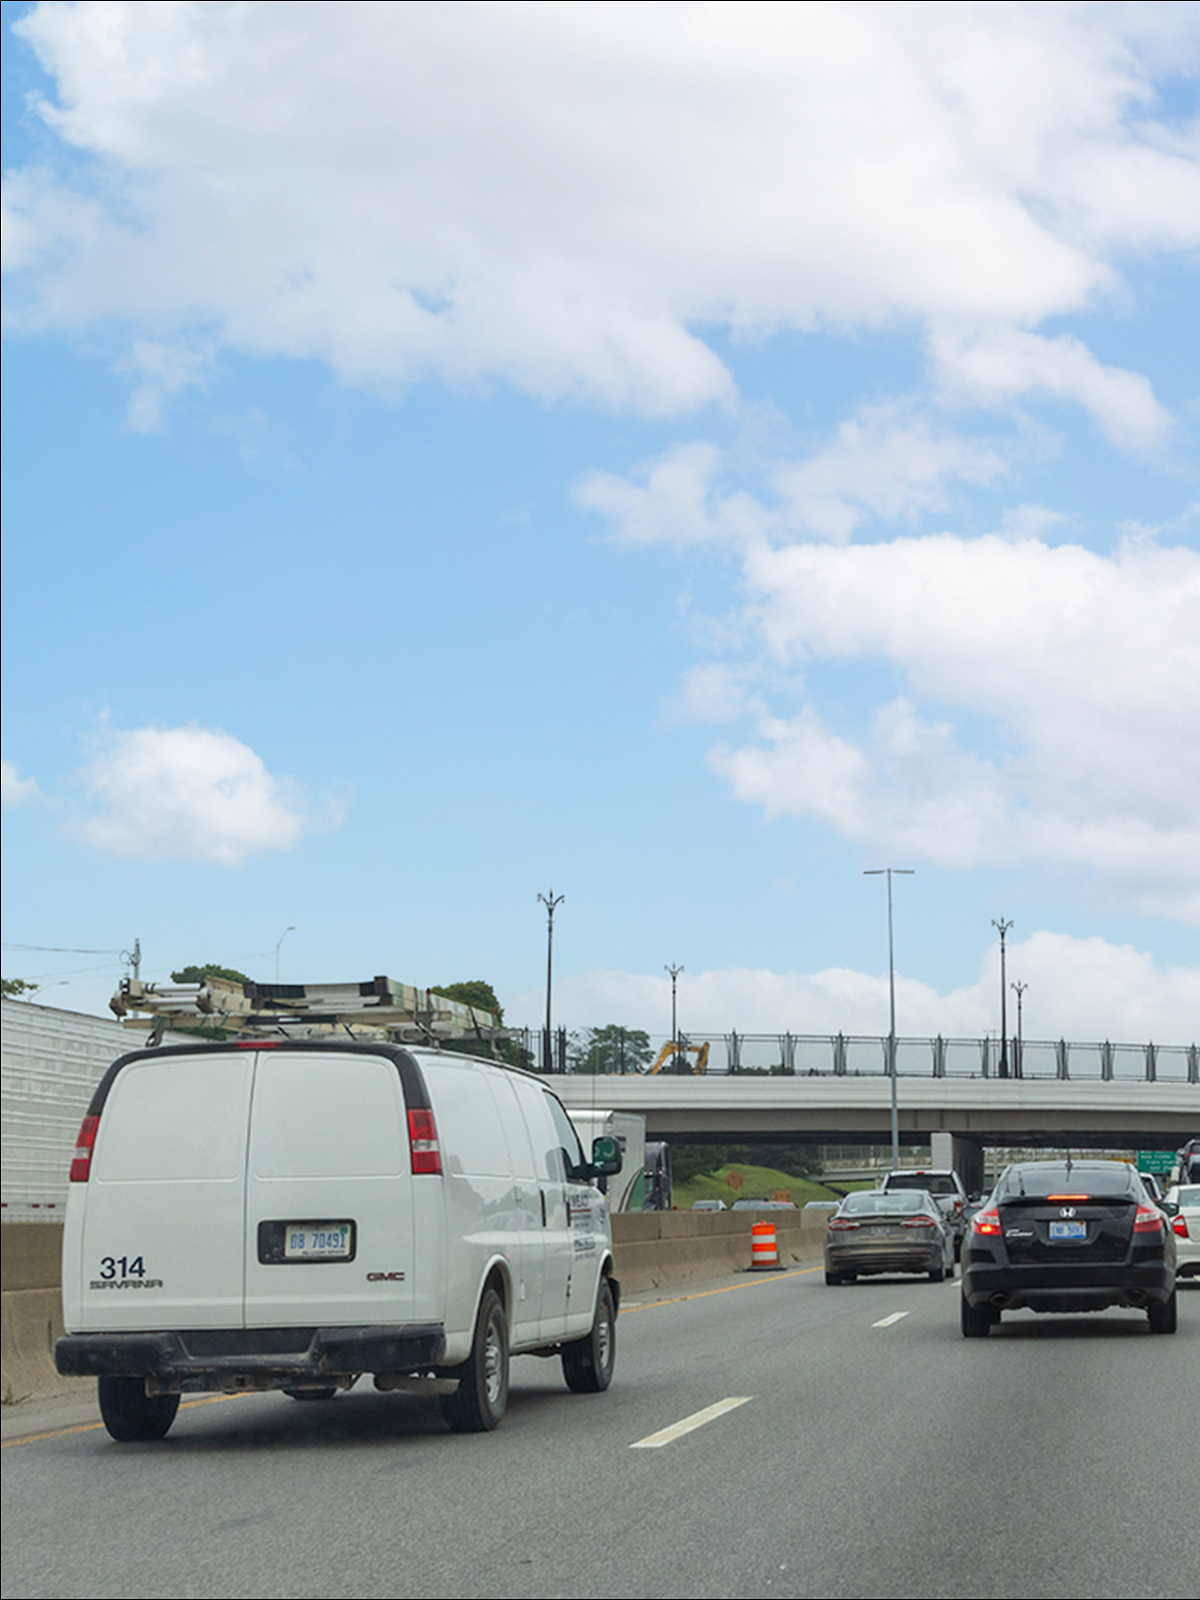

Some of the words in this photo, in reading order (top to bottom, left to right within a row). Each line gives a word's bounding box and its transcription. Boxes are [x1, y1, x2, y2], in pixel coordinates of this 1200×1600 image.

[312, 1232, 347, 1249] 70491
[100, 1256, 146, 1280] 314
[366, 1272, 405, 1282] GMC
[89, 1279, 163, 1290] SAVANA
